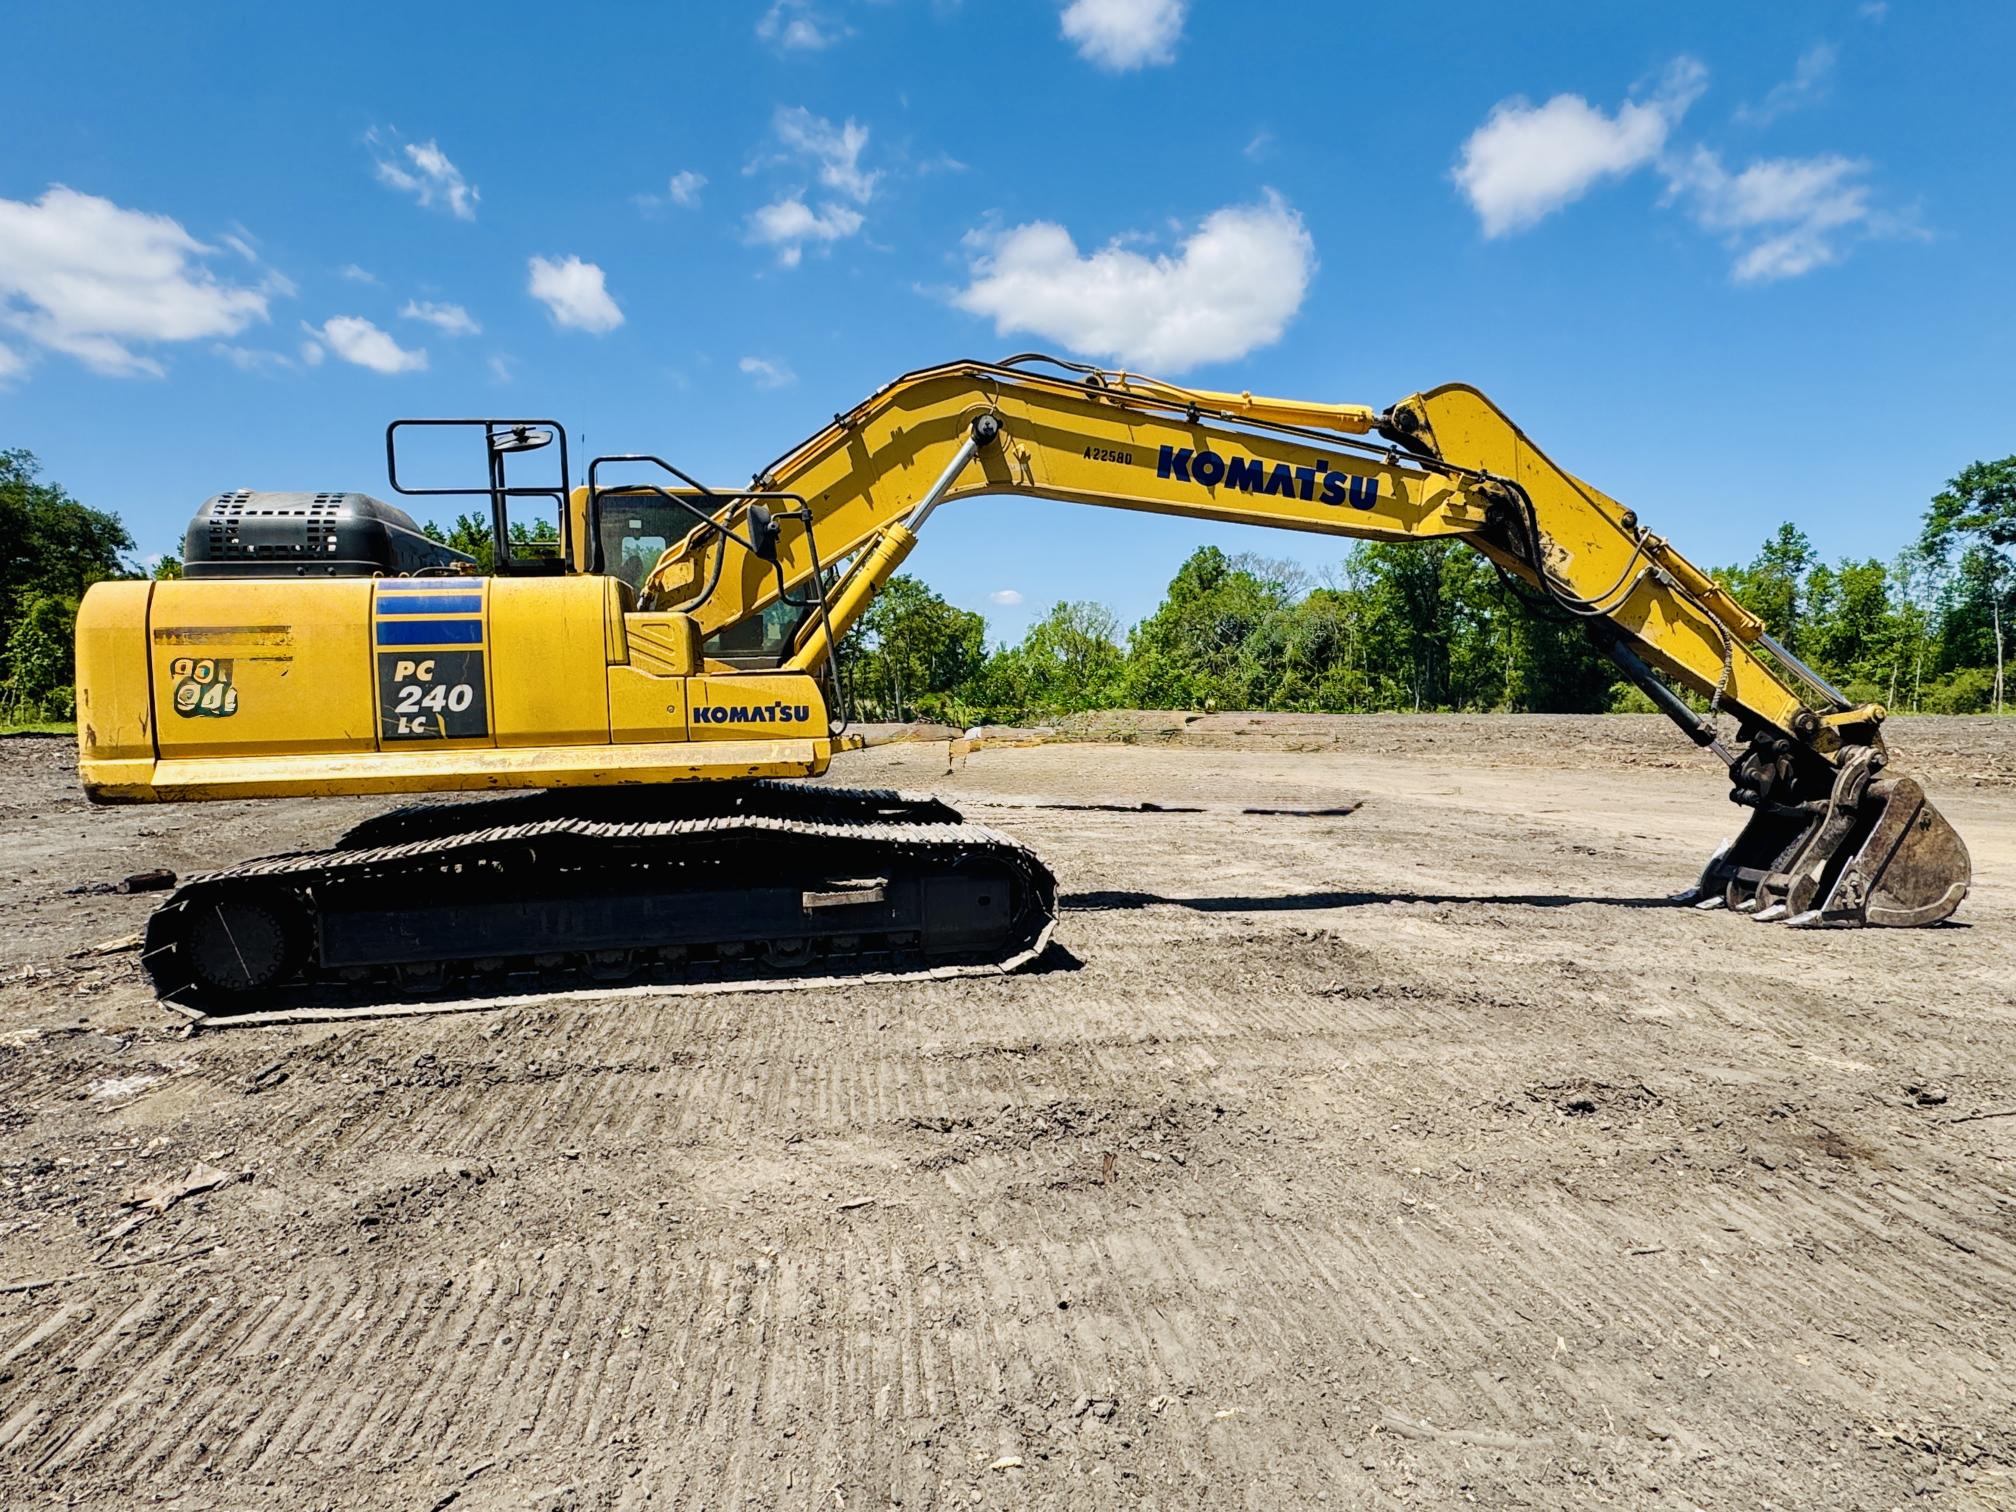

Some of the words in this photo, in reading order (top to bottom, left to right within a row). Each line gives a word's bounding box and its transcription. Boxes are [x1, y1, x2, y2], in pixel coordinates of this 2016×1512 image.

[1083, 446, 1132, 465] A22580
[1157, 445, 1379, 510] KOMATSU
[394, 660, 435, 682] PC
[394, 684, 473, 713] 240
[693, 701, 809, 723] KOMATSU
[397, 716, 427, 734] LC
